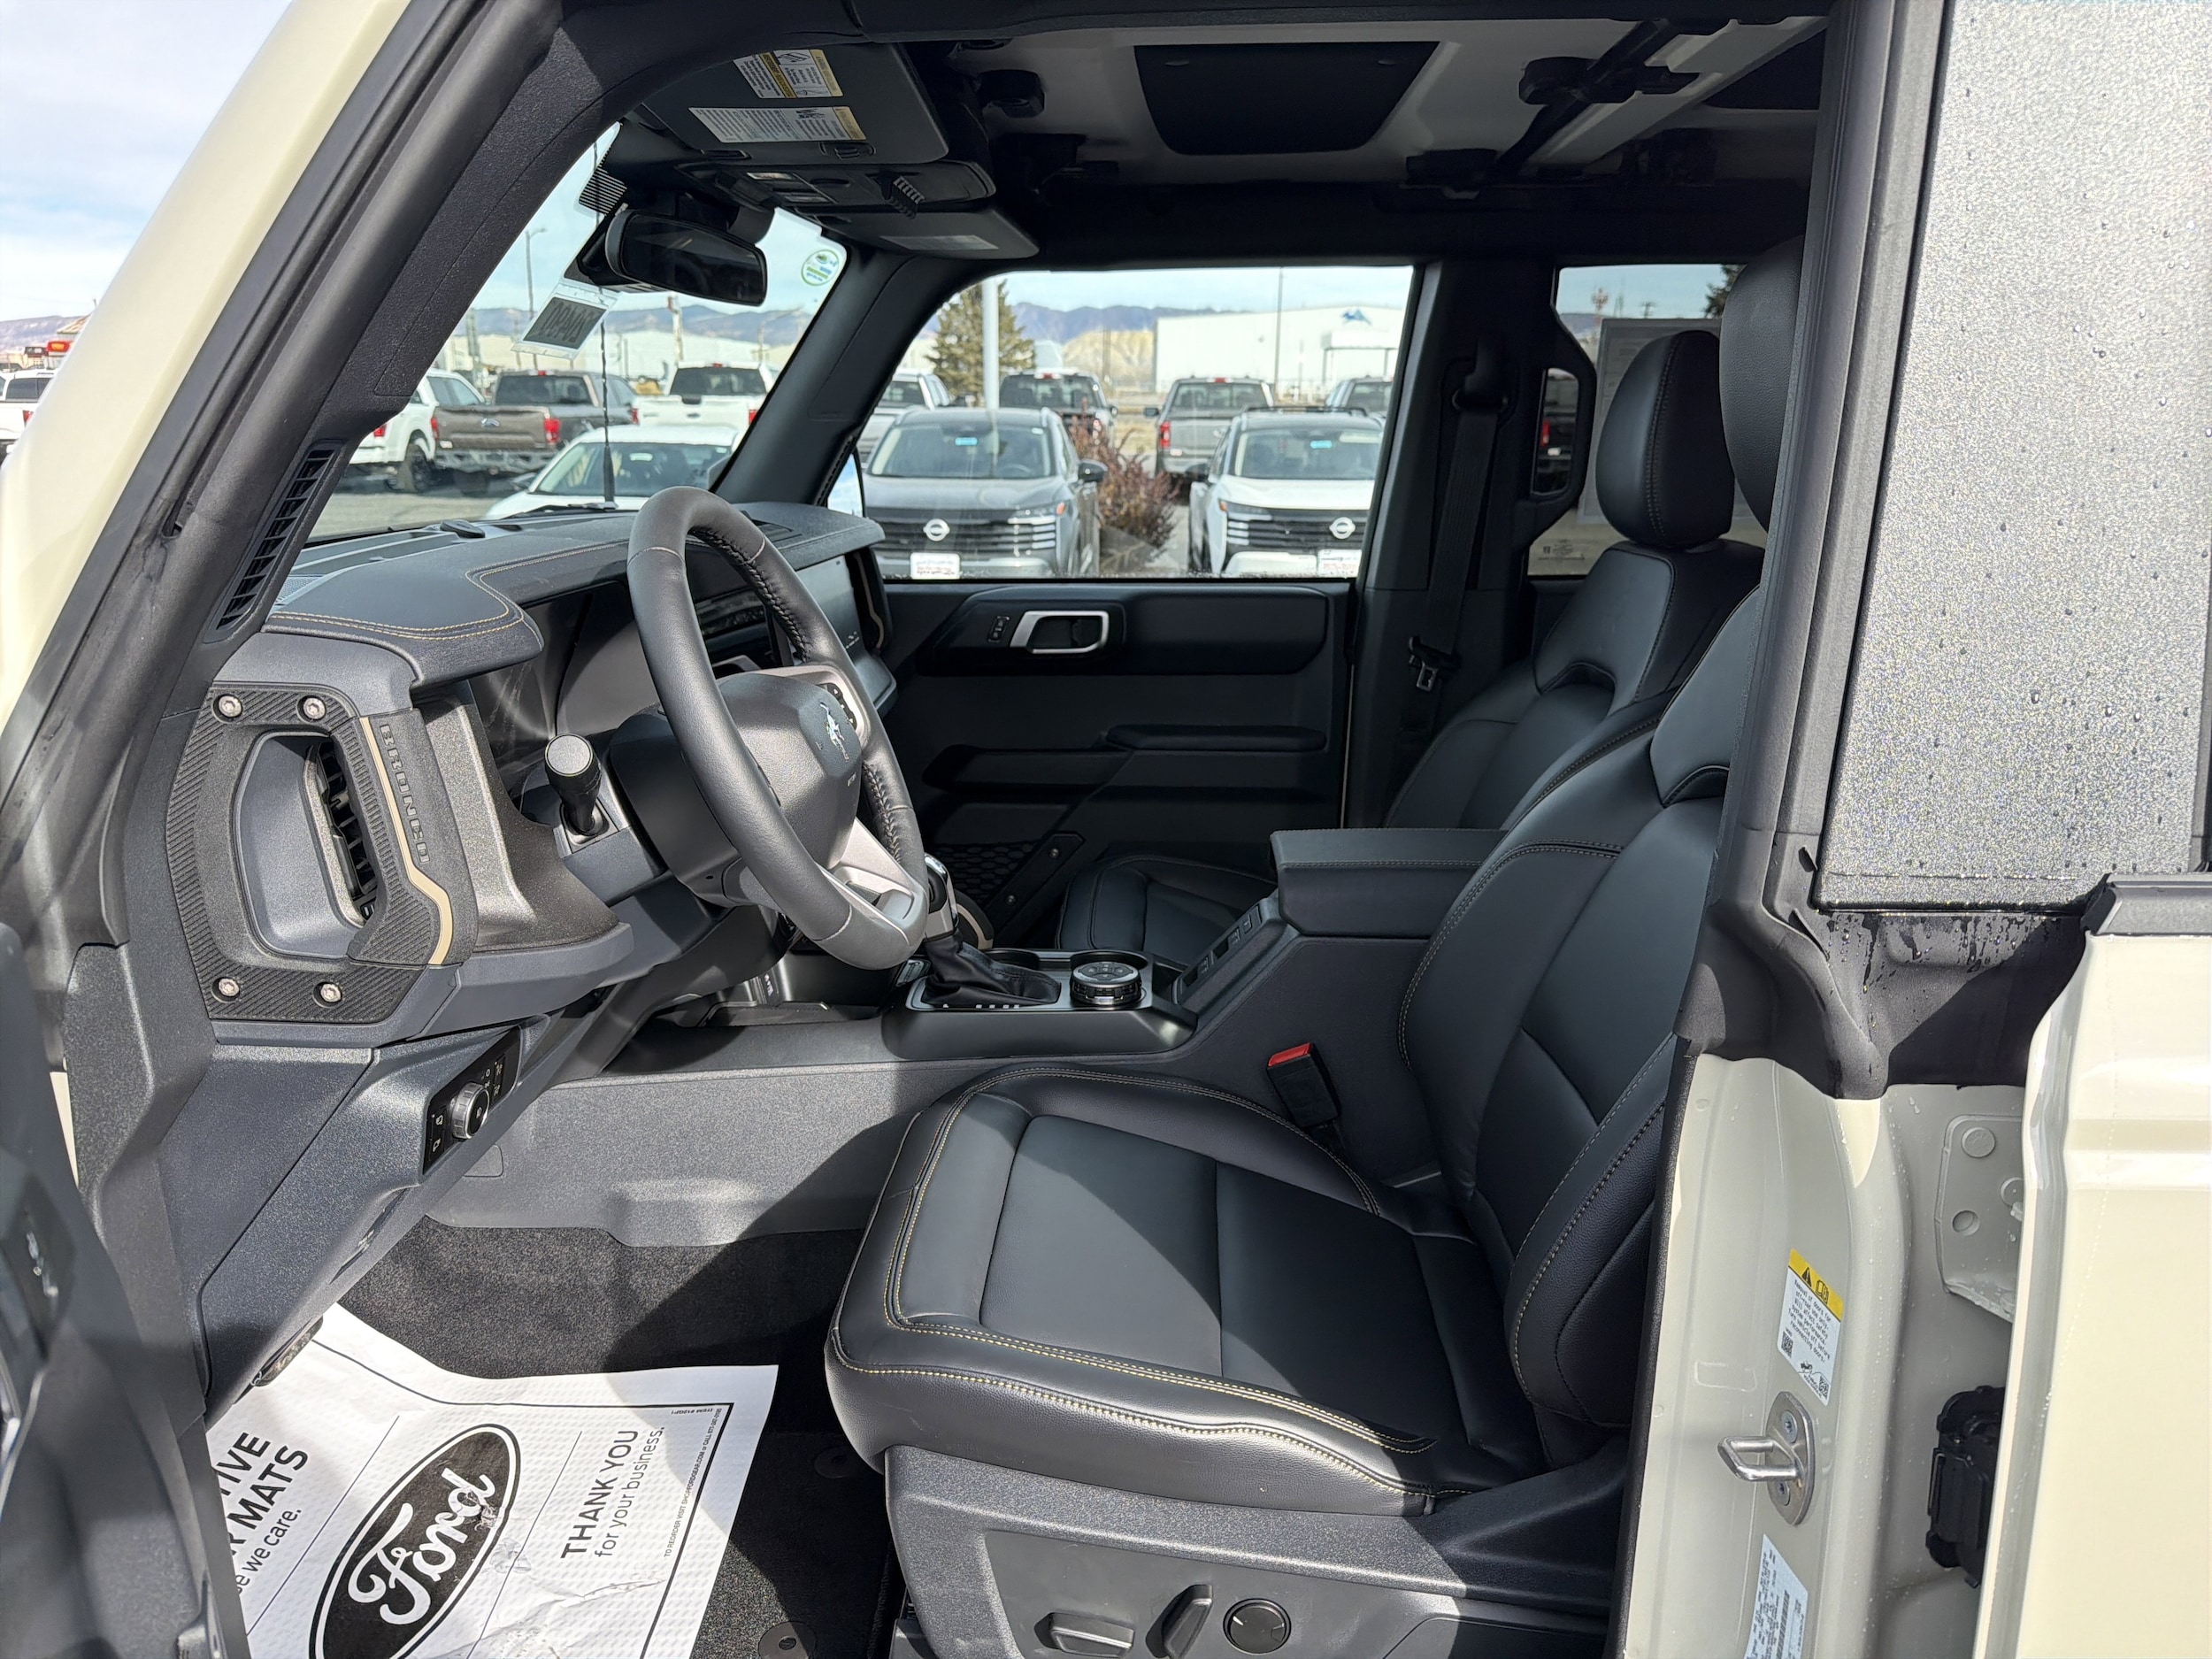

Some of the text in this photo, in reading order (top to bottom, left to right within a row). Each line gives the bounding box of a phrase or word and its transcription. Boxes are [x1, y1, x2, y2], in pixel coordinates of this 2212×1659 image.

[380, 724, 430, 863] BRONCO
[703, 1433, 712, 1446] CALL
[227, 1445, 308, 1530] MATS
[560, 1431, 639, 1558] THANK YOU
[595, 1427, 664, 1557] for your business.
[676, 1505, 687, 1520] VISIT
[242, 1547, 271, 1572] we
[264, 1509, 302, 1546] care.
[348, 1467, 495, 1625] Ford
[664, 1547, 672, 1558] TO
[667, 1519, 681, 1548] REORDER
